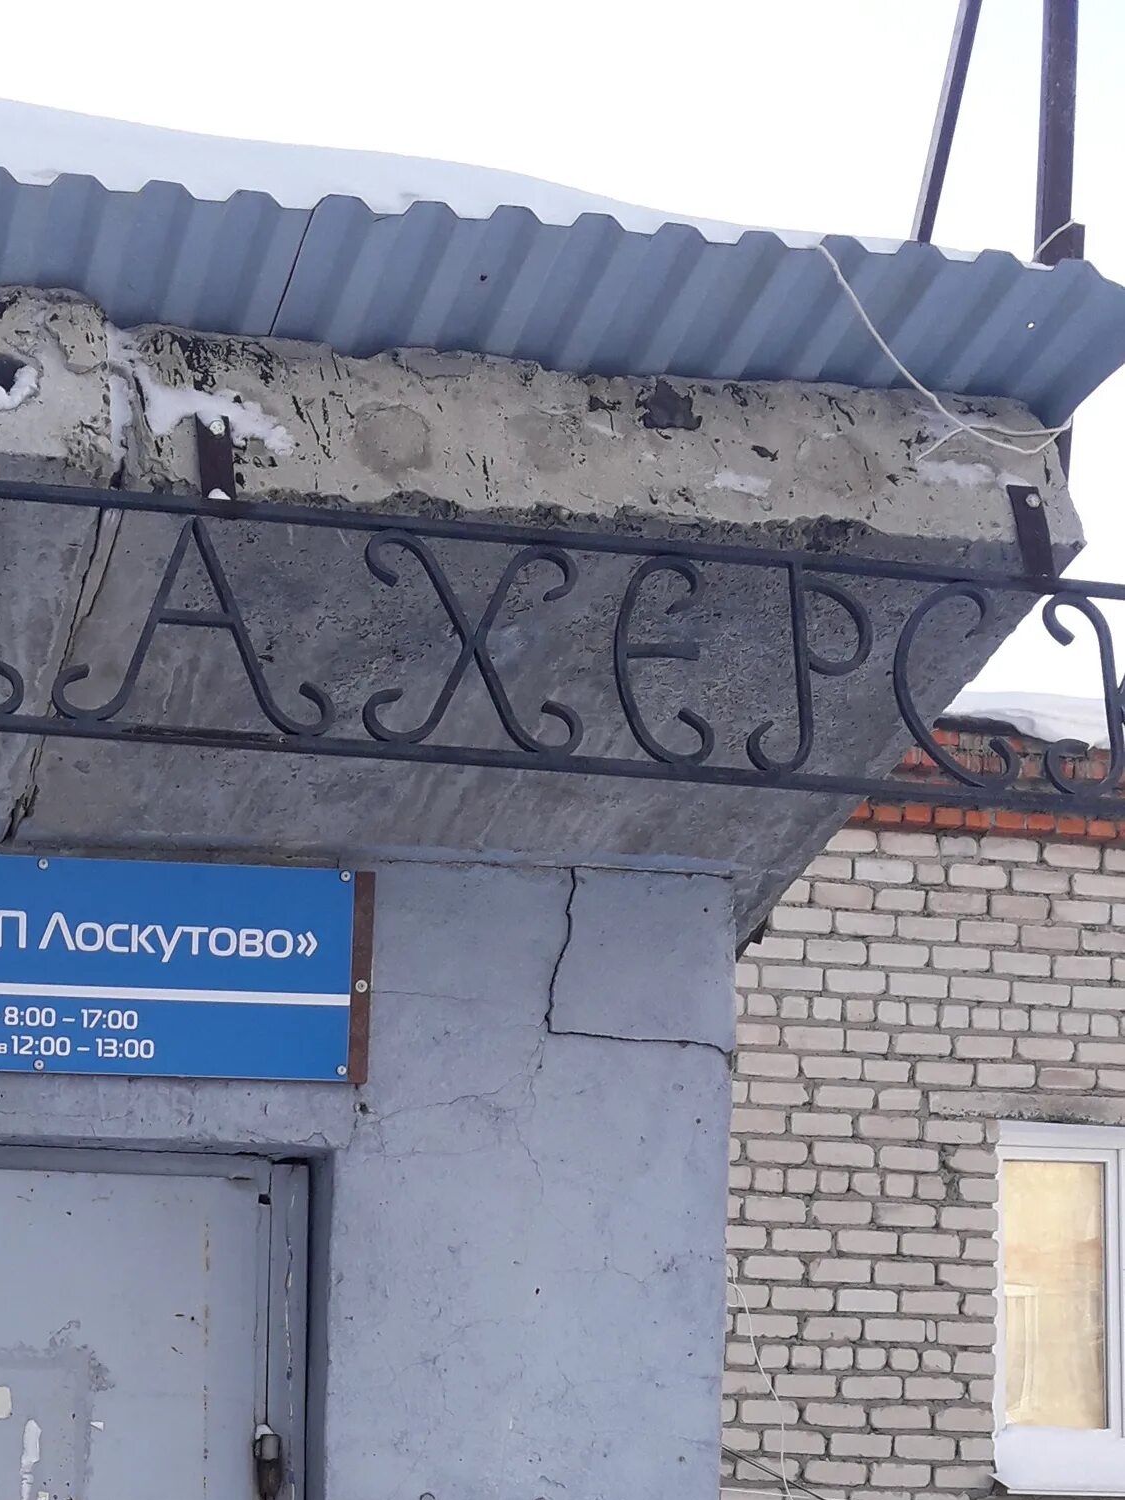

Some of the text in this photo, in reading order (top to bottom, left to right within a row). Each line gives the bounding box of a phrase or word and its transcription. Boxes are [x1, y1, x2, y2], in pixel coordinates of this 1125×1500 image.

[38, 911, 318, 962] Лоскутово»
[3, 1006, 56, 1027] 8:00
[81, 1009, 139, 1030] 17:00
[11, 1035, 71, 1056] 12:00
[95, 1038, 155, 1059] 13:00
